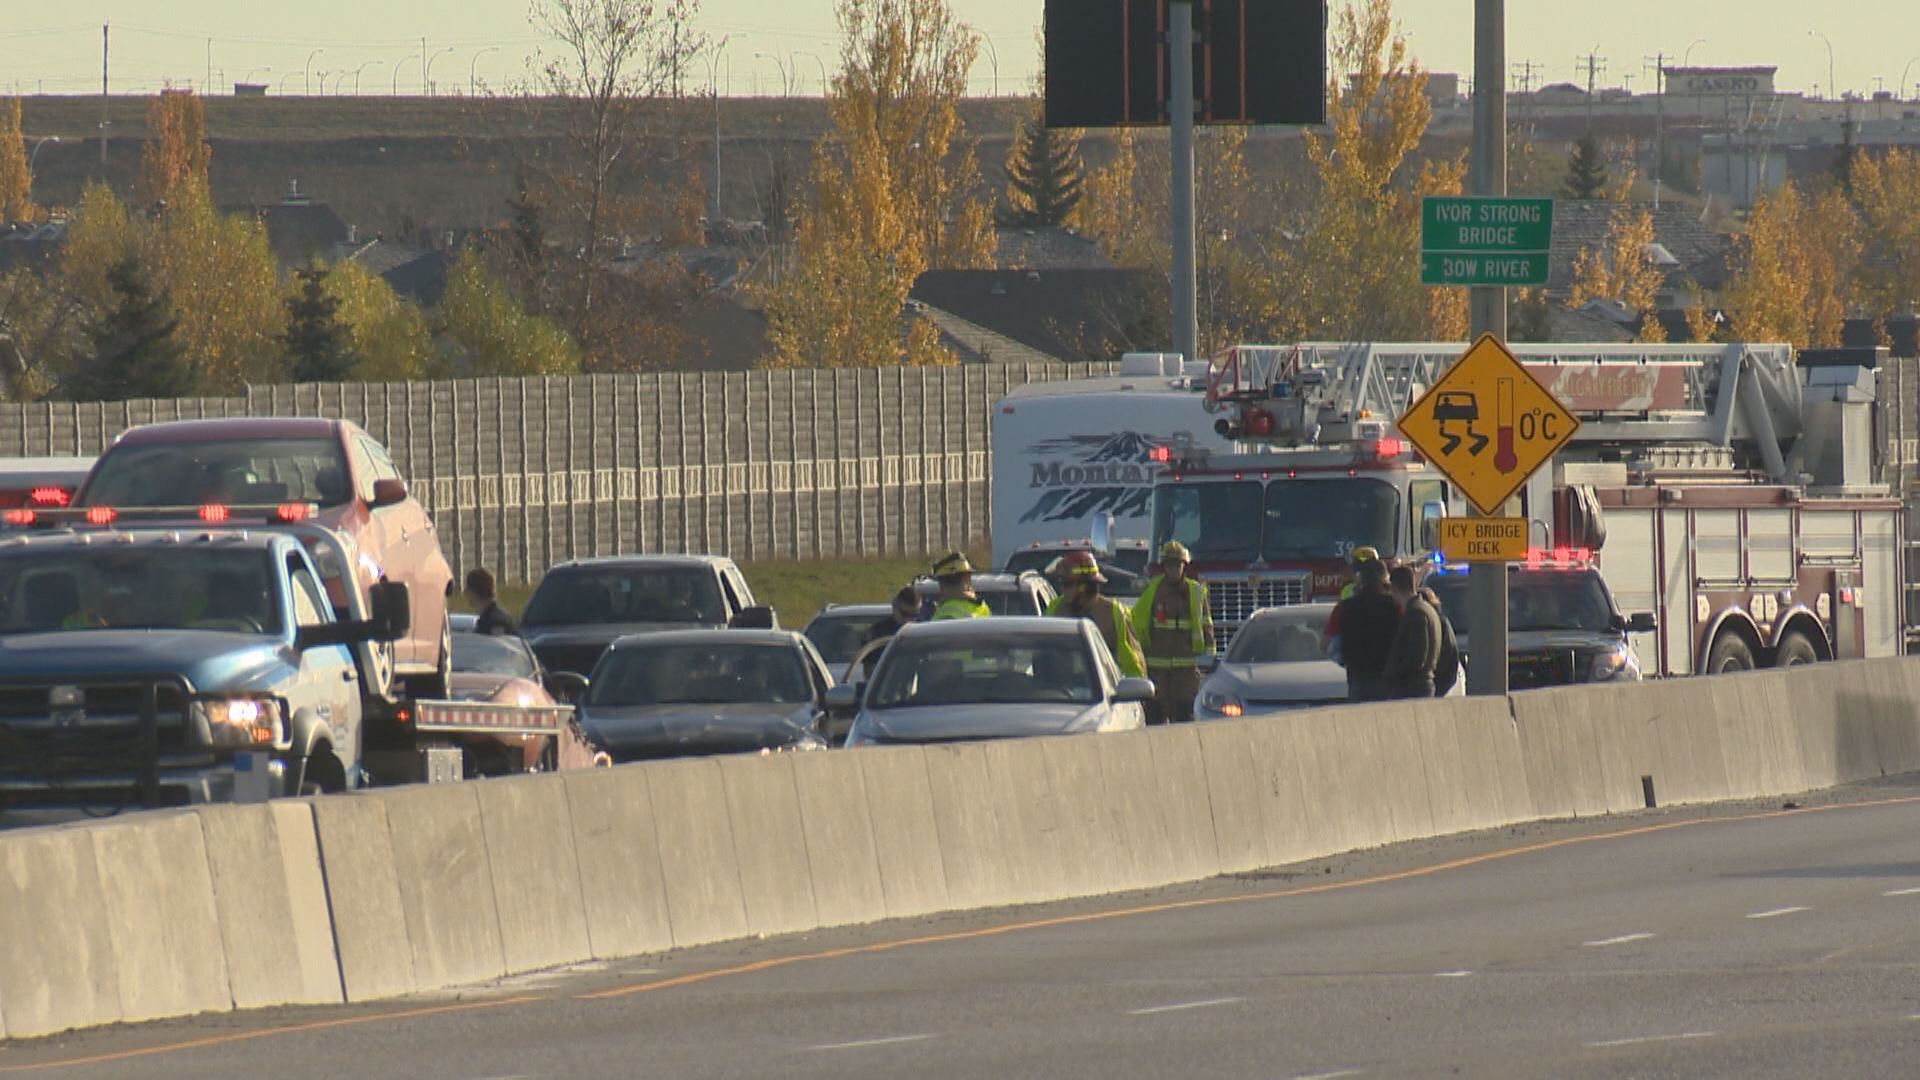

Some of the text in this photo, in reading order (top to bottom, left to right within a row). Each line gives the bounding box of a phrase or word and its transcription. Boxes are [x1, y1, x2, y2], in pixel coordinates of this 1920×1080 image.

[1436, 204, 1541, 223] IVOR STRONG
[1459, 226, 1517, 245] BRIDGE
[1485, 259, 1530, 278] RIVER
[1447, 524, 1521, 538] ICY BRIDGE
[1468, 541, 1500, 554] DECK
